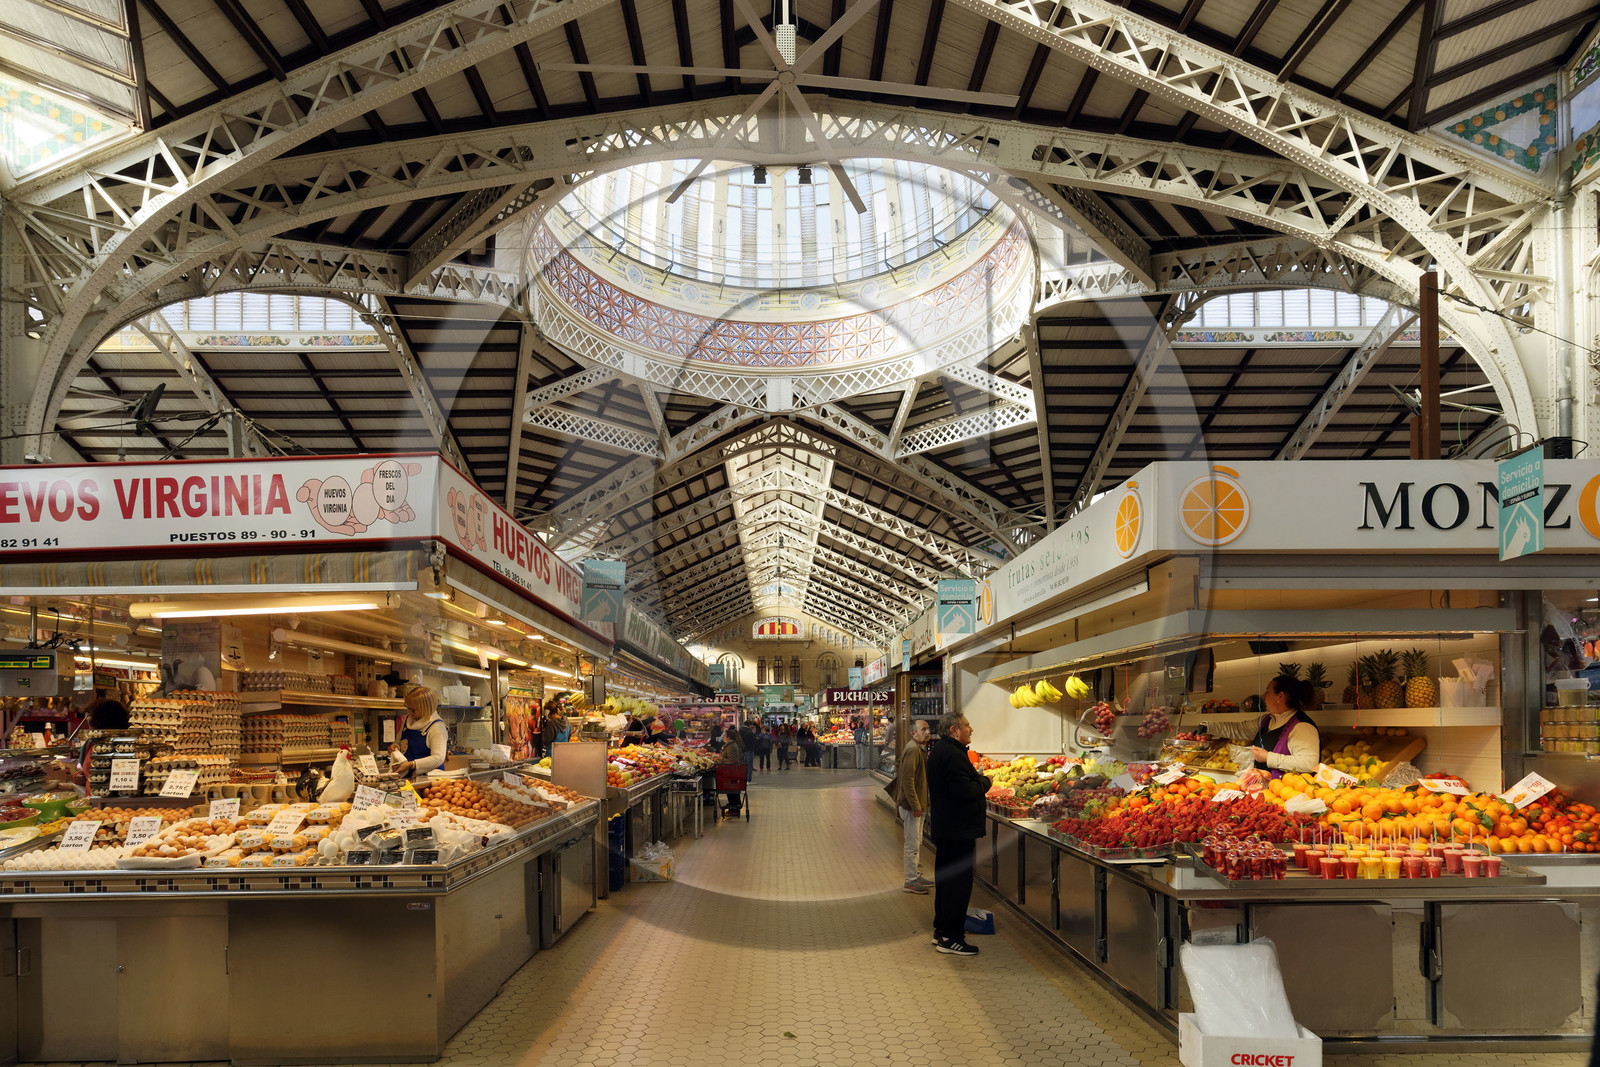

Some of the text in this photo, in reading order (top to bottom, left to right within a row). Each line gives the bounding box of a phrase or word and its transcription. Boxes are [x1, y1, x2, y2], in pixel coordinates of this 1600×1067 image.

[379, 470, 402, 479] FRESCOS
[1501, 464, 1533, 484] Servicio
[385, 482, 396, 490] DEL
[1502, 476, 1540, 499] domicilio
[0, 474, 292, 523] EVOS VIRGINIA
[324, 489, 346, 498] HUEVOS
[386, 495, 396, 504] DIA
[323, 504, 348, 513] VIRGINIA
[170, 531, 236, 542] PUESTOS
[240, 530, 258, 540] 89
[270, 530, 288, 540] 90
[300, 529, 316, 538] 91
[0, 538, 59, 548] 82 91 41
[493, 511, 583, 607] HUEVOS VIRGI
[586, 565, 616, 575] Servicio
[1008, 561, 1035, 589] frutas
[492, 560, 532, 592] TEL. 96 382 91 41
[586, 576, 622, 585] domicilio
[833, 691, 888, 702] PUCHADES
[1230, 1053, 1295, 1067] CRICKET
